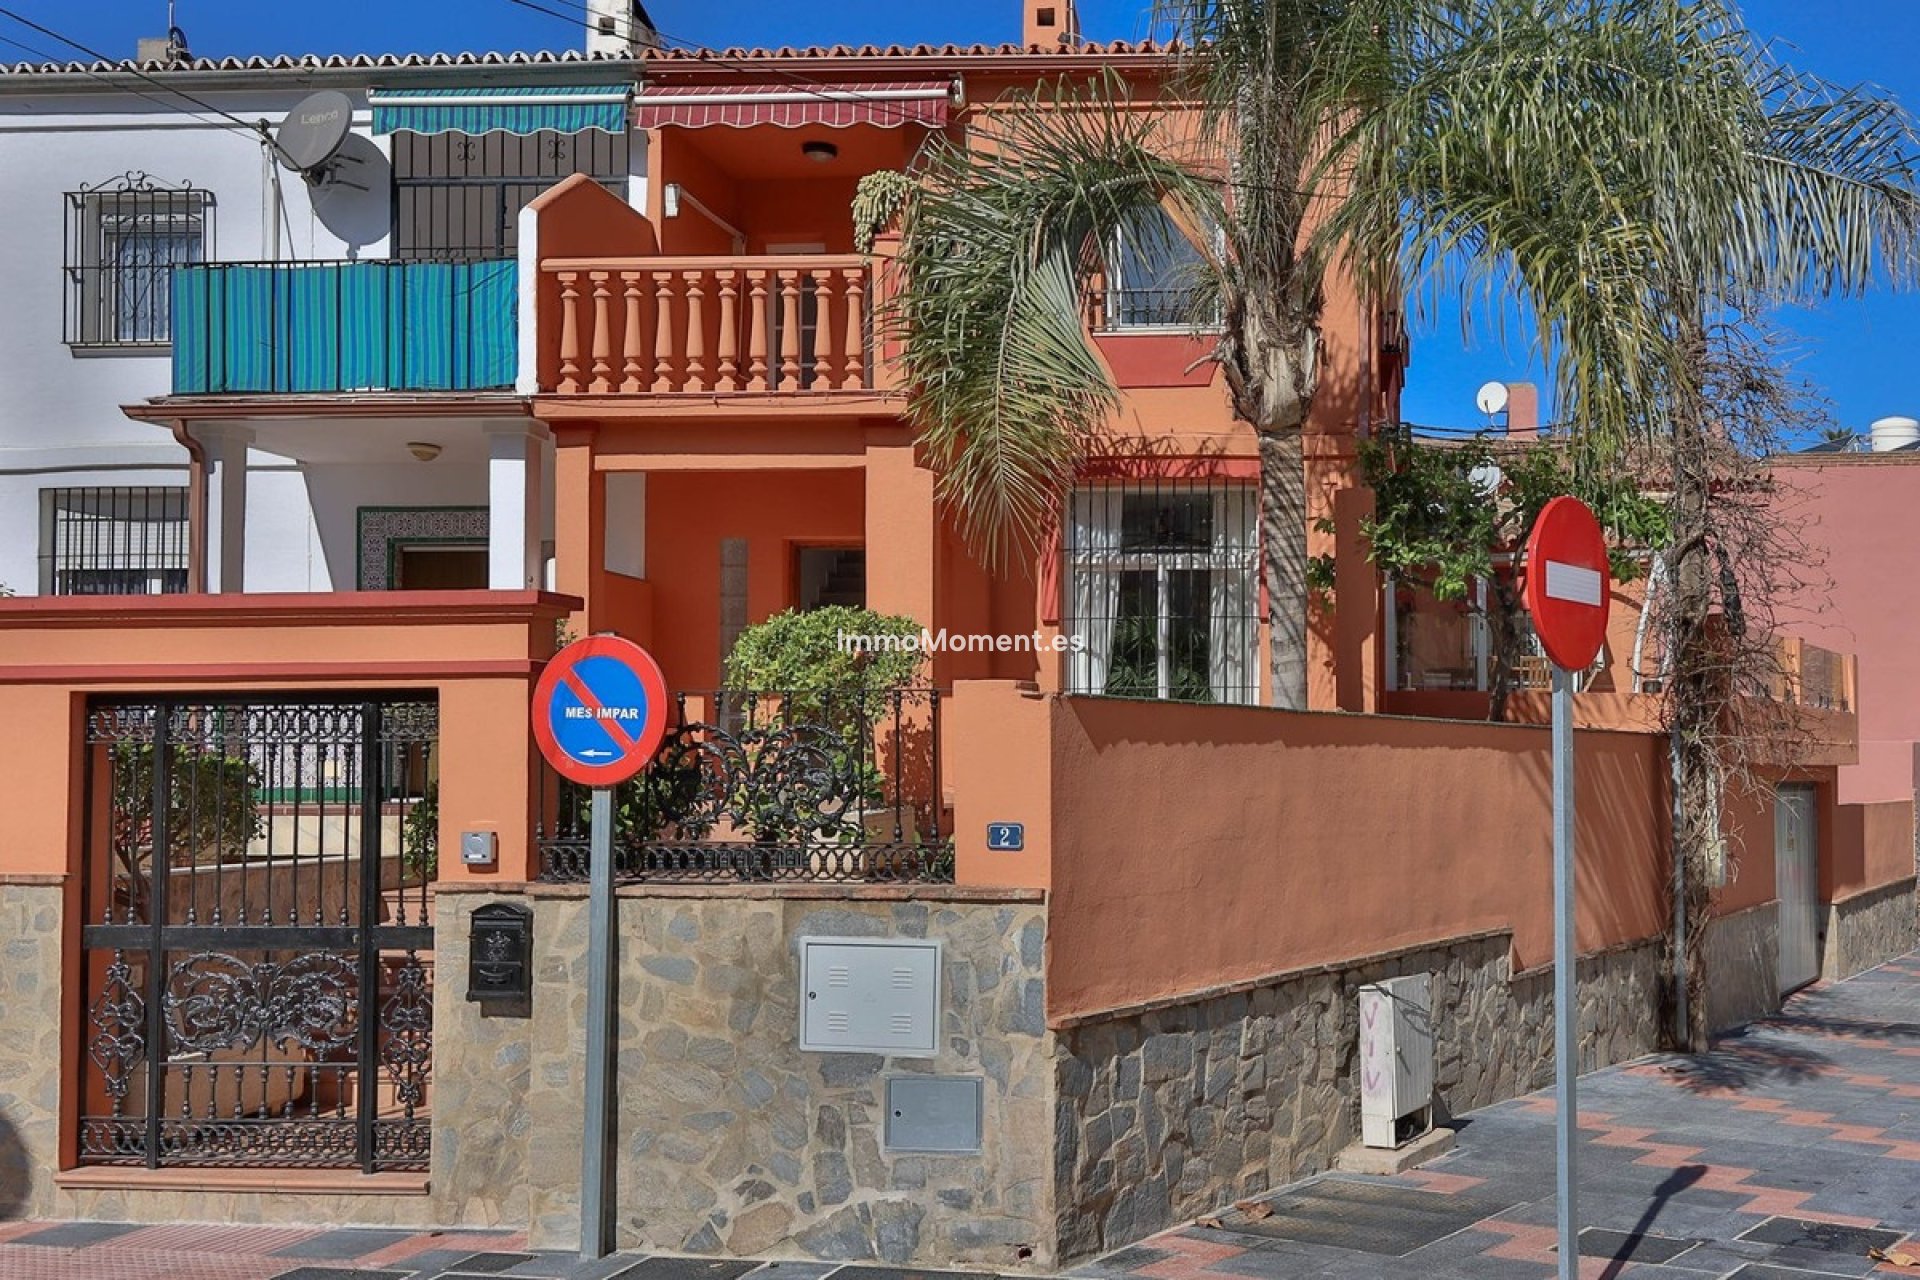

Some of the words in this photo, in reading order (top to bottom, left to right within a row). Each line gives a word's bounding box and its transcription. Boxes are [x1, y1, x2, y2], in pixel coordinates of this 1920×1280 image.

[565, 706, 593, 719] MES
[597, 707, 639, 719] IMPAR
[1000, 828, 1009, 846] 2
